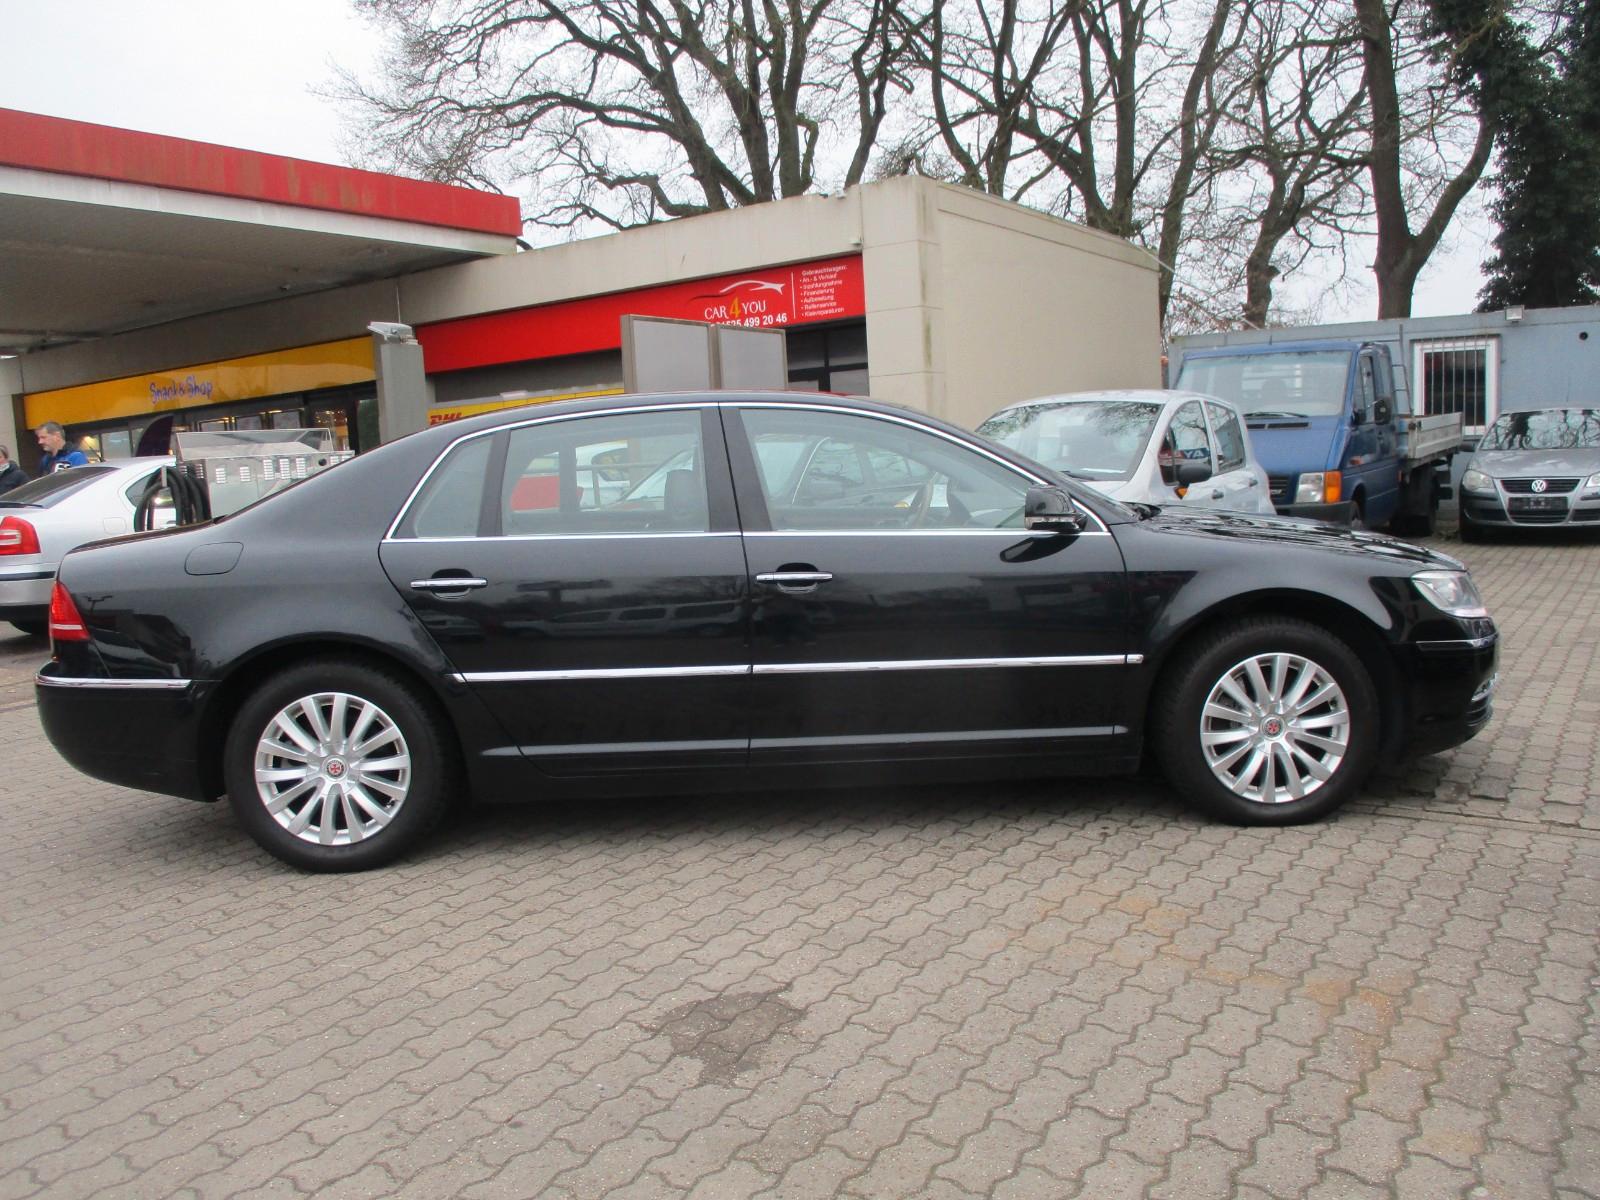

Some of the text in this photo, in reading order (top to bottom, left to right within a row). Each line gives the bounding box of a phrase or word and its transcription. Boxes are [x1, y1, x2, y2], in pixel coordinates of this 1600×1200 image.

[704, 297, 766, 320] CAR 4 YOU
[744, 316, 760, 328] 499
[762, 314, 774, 326] 20
[776, 312, 788, 324] 46
[186, 375, 213, 399] Shop
